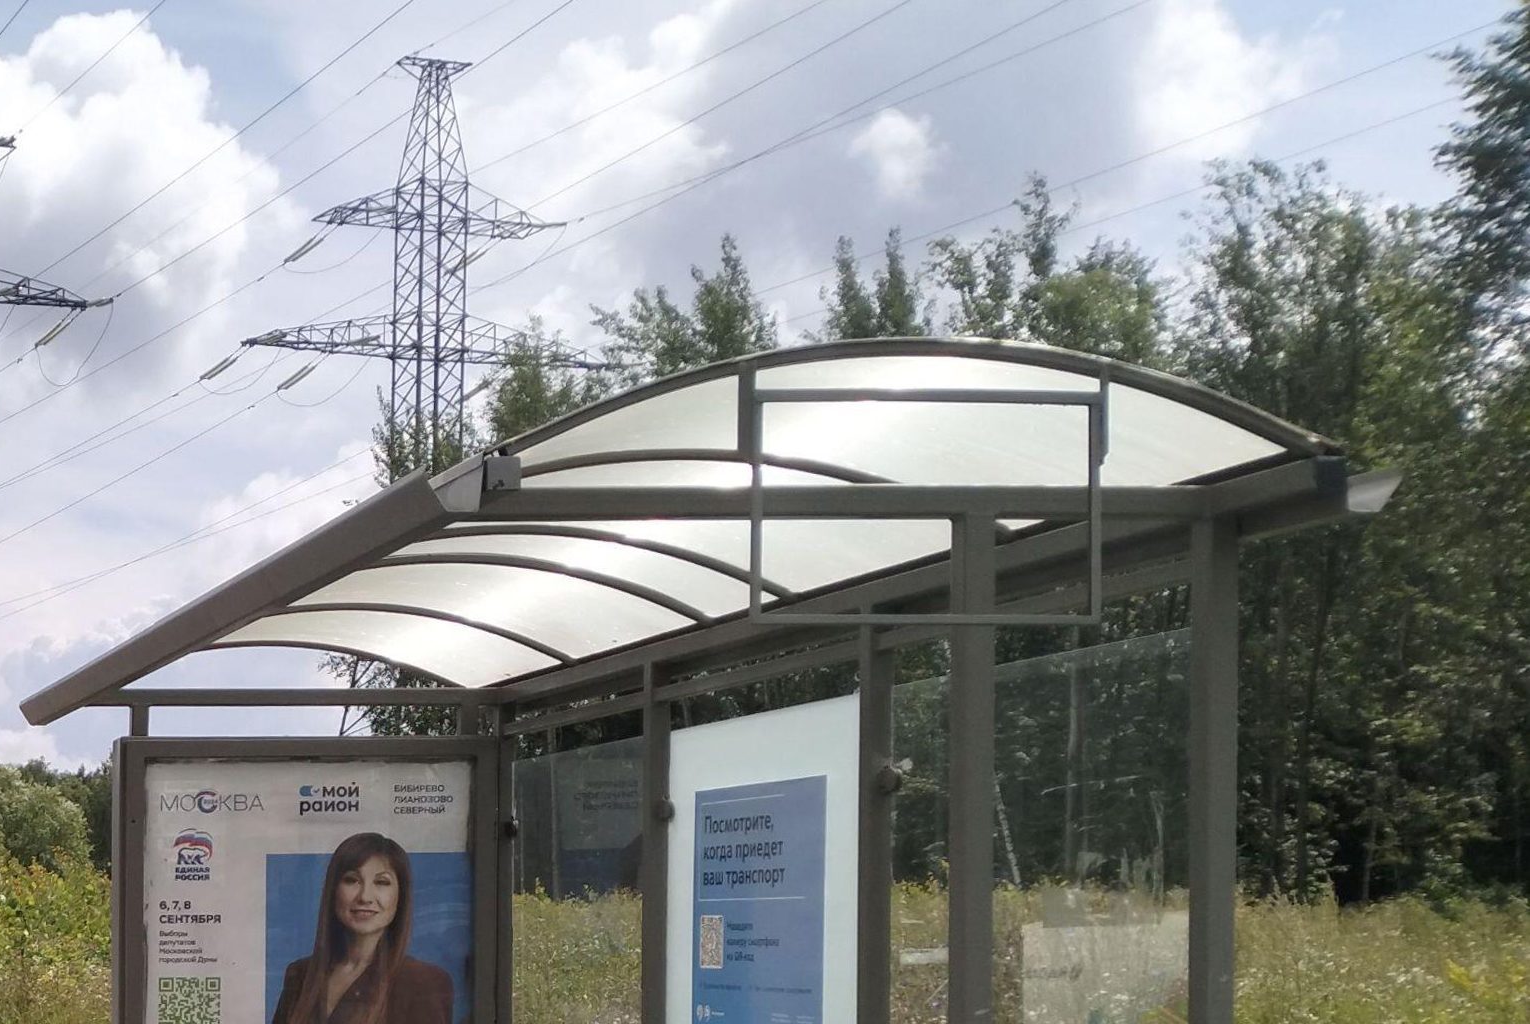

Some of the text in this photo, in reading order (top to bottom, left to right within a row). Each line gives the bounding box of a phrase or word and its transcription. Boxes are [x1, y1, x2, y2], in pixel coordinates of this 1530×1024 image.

[393, 784, 446, 793] БИБИРЕВО
[159, 790, 265, 814] МОСКВА
[393, 795, 454, 804] ЛИАНОЗОВО
[393, 805, 446, 815] СЕВЕРНЫЙ
[704, 814, 774, 835] Посмотрите,
[703, 840, 783, 862] когда приедет
[702, 867, 786, 889] ваш транспорт
[159, 900, 191, 911] 6, 7, 8
[159, 914, 222, 924] СЕНТЯБРЯ
